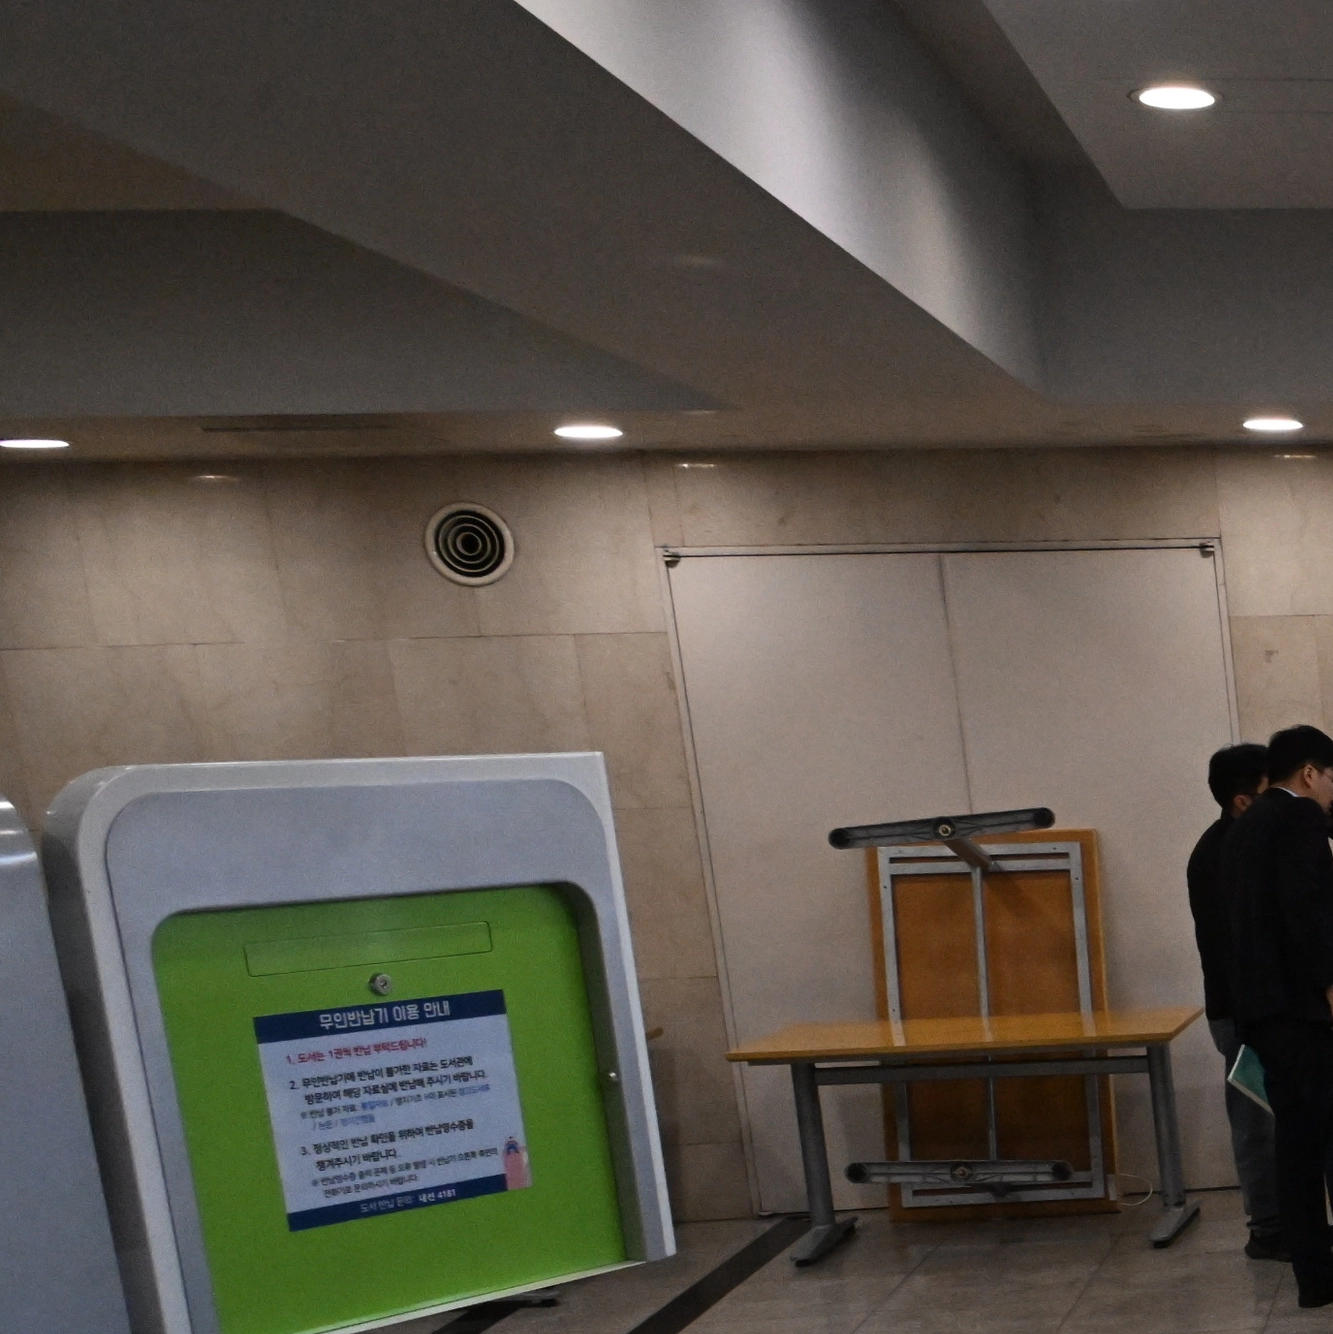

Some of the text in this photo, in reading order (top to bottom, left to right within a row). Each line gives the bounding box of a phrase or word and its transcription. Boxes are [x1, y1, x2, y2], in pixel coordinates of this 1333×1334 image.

[320, 1000, 450, 1030] 무인반납기 이용 안내
[298, 1050, 325, 1063] 도서는
[353, 1044, 371, 1057] 반납
[289, 1080, 300, 1090] 2.
[302, 1071, 355, 1088] 무인반납기에
[357, 1067, 383, 1081] 반납이
[413, 1060, 439, 1073] 자료는
[440, 1055, 473, 1069] 도서관에
[305, 1089, 341, 1105] 방문하여
[343, 1087, 361, 1098] 해당
[363, 1081, 397, 1095] 자료실에
[427, 1074, 452, 1087] 주시기
[313, 1140, 349, 1154] 정상적인
[351, 1136, 368, 1148] 반납
[370, 1131, 396, 1145] 확인을
[398, 1126, 424, 1140] 위하여
[425, 1118, 474, 1135] 반납영수증을
[361, 1202, 377, 1213] 도서
[418, 1192, 436, 1202] 내선
